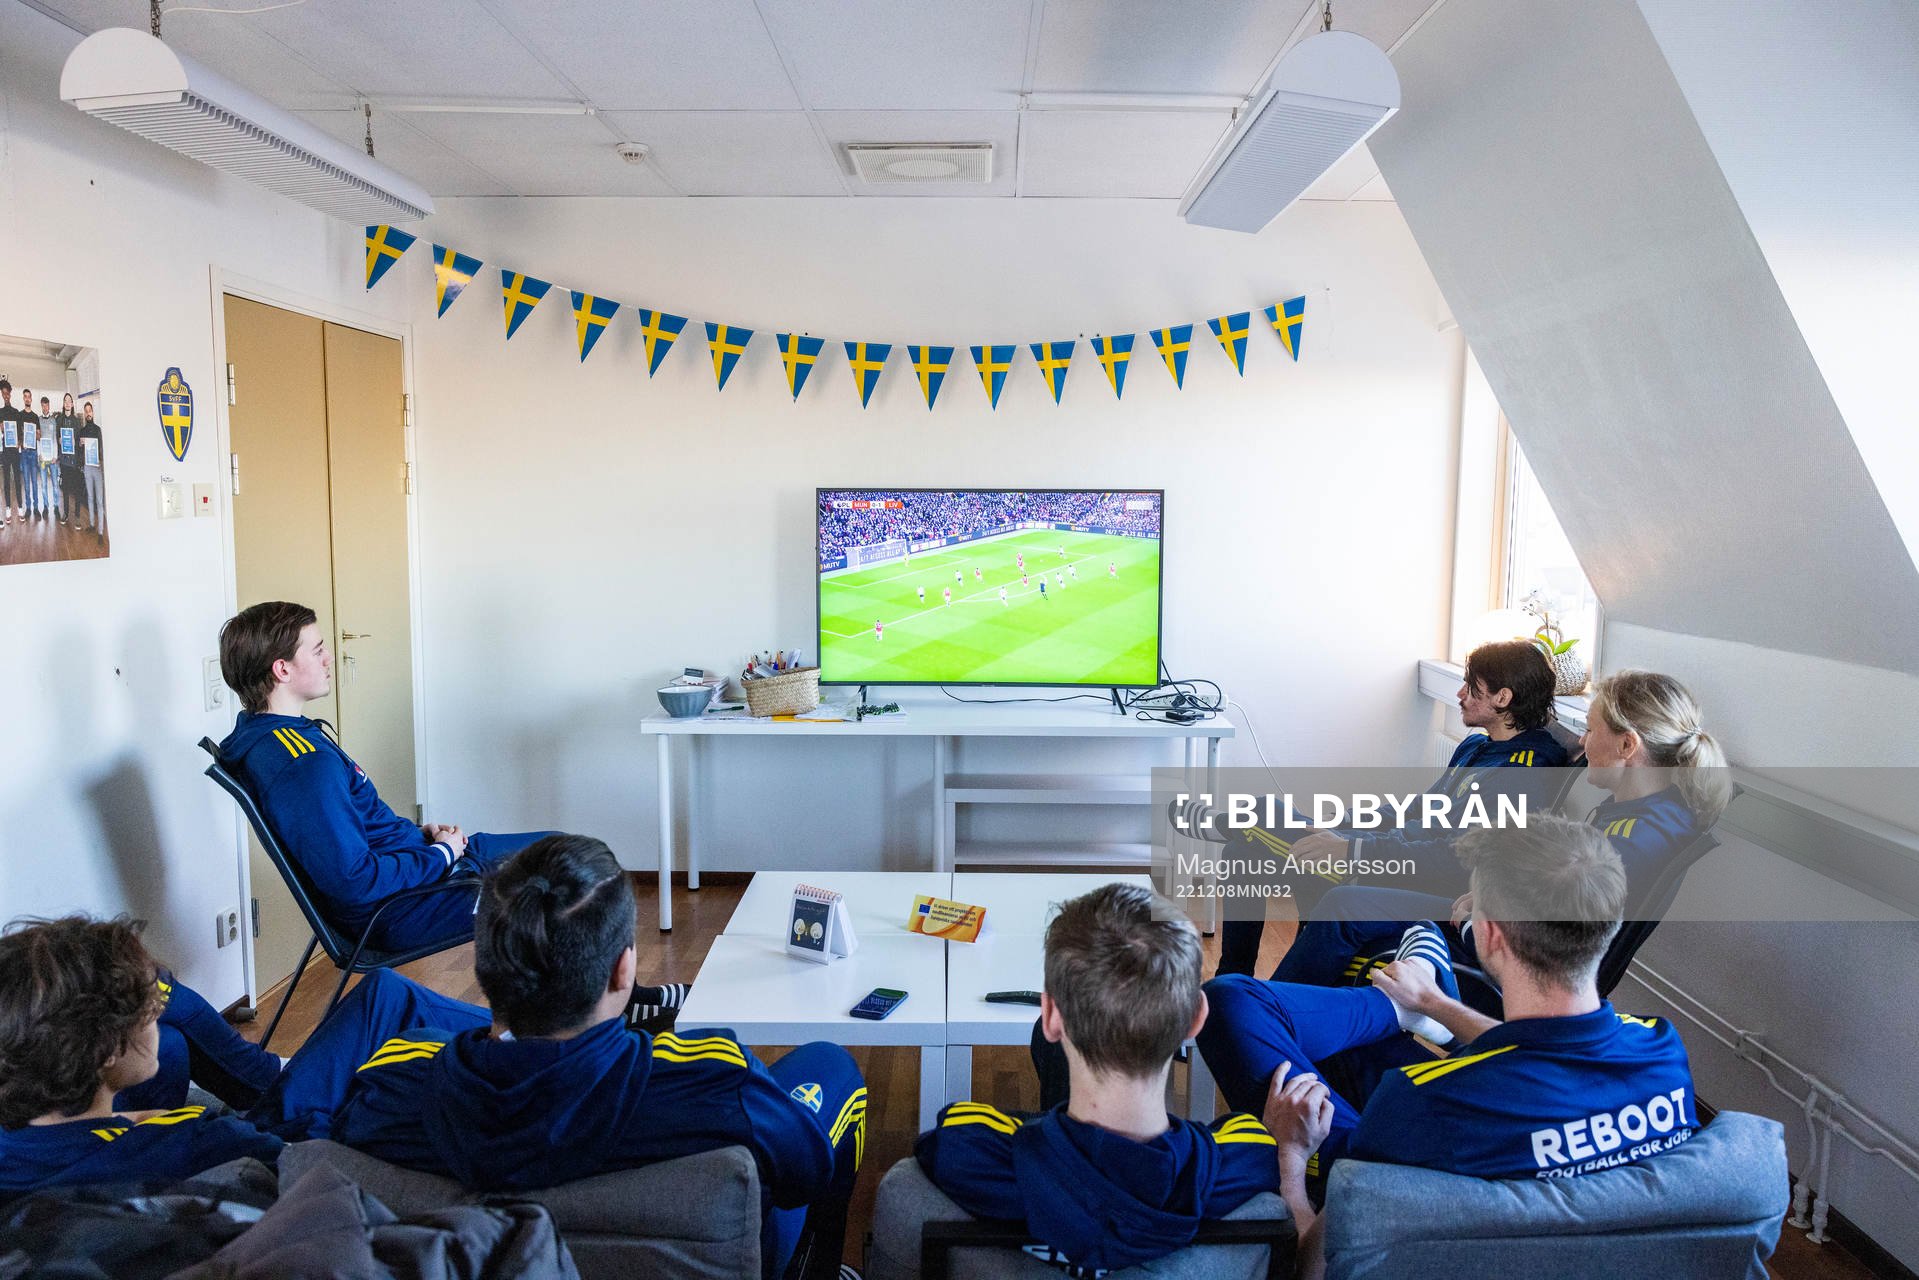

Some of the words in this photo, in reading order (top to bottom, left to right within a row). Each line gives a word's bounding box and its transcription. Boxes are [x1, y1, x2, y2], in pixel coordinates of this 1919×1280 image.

[823, 561, 840, 570] MUTV
[1531, 1087, 1688, 1168] REBOOT
[1630, 1139, 1664, 1161] FOR
